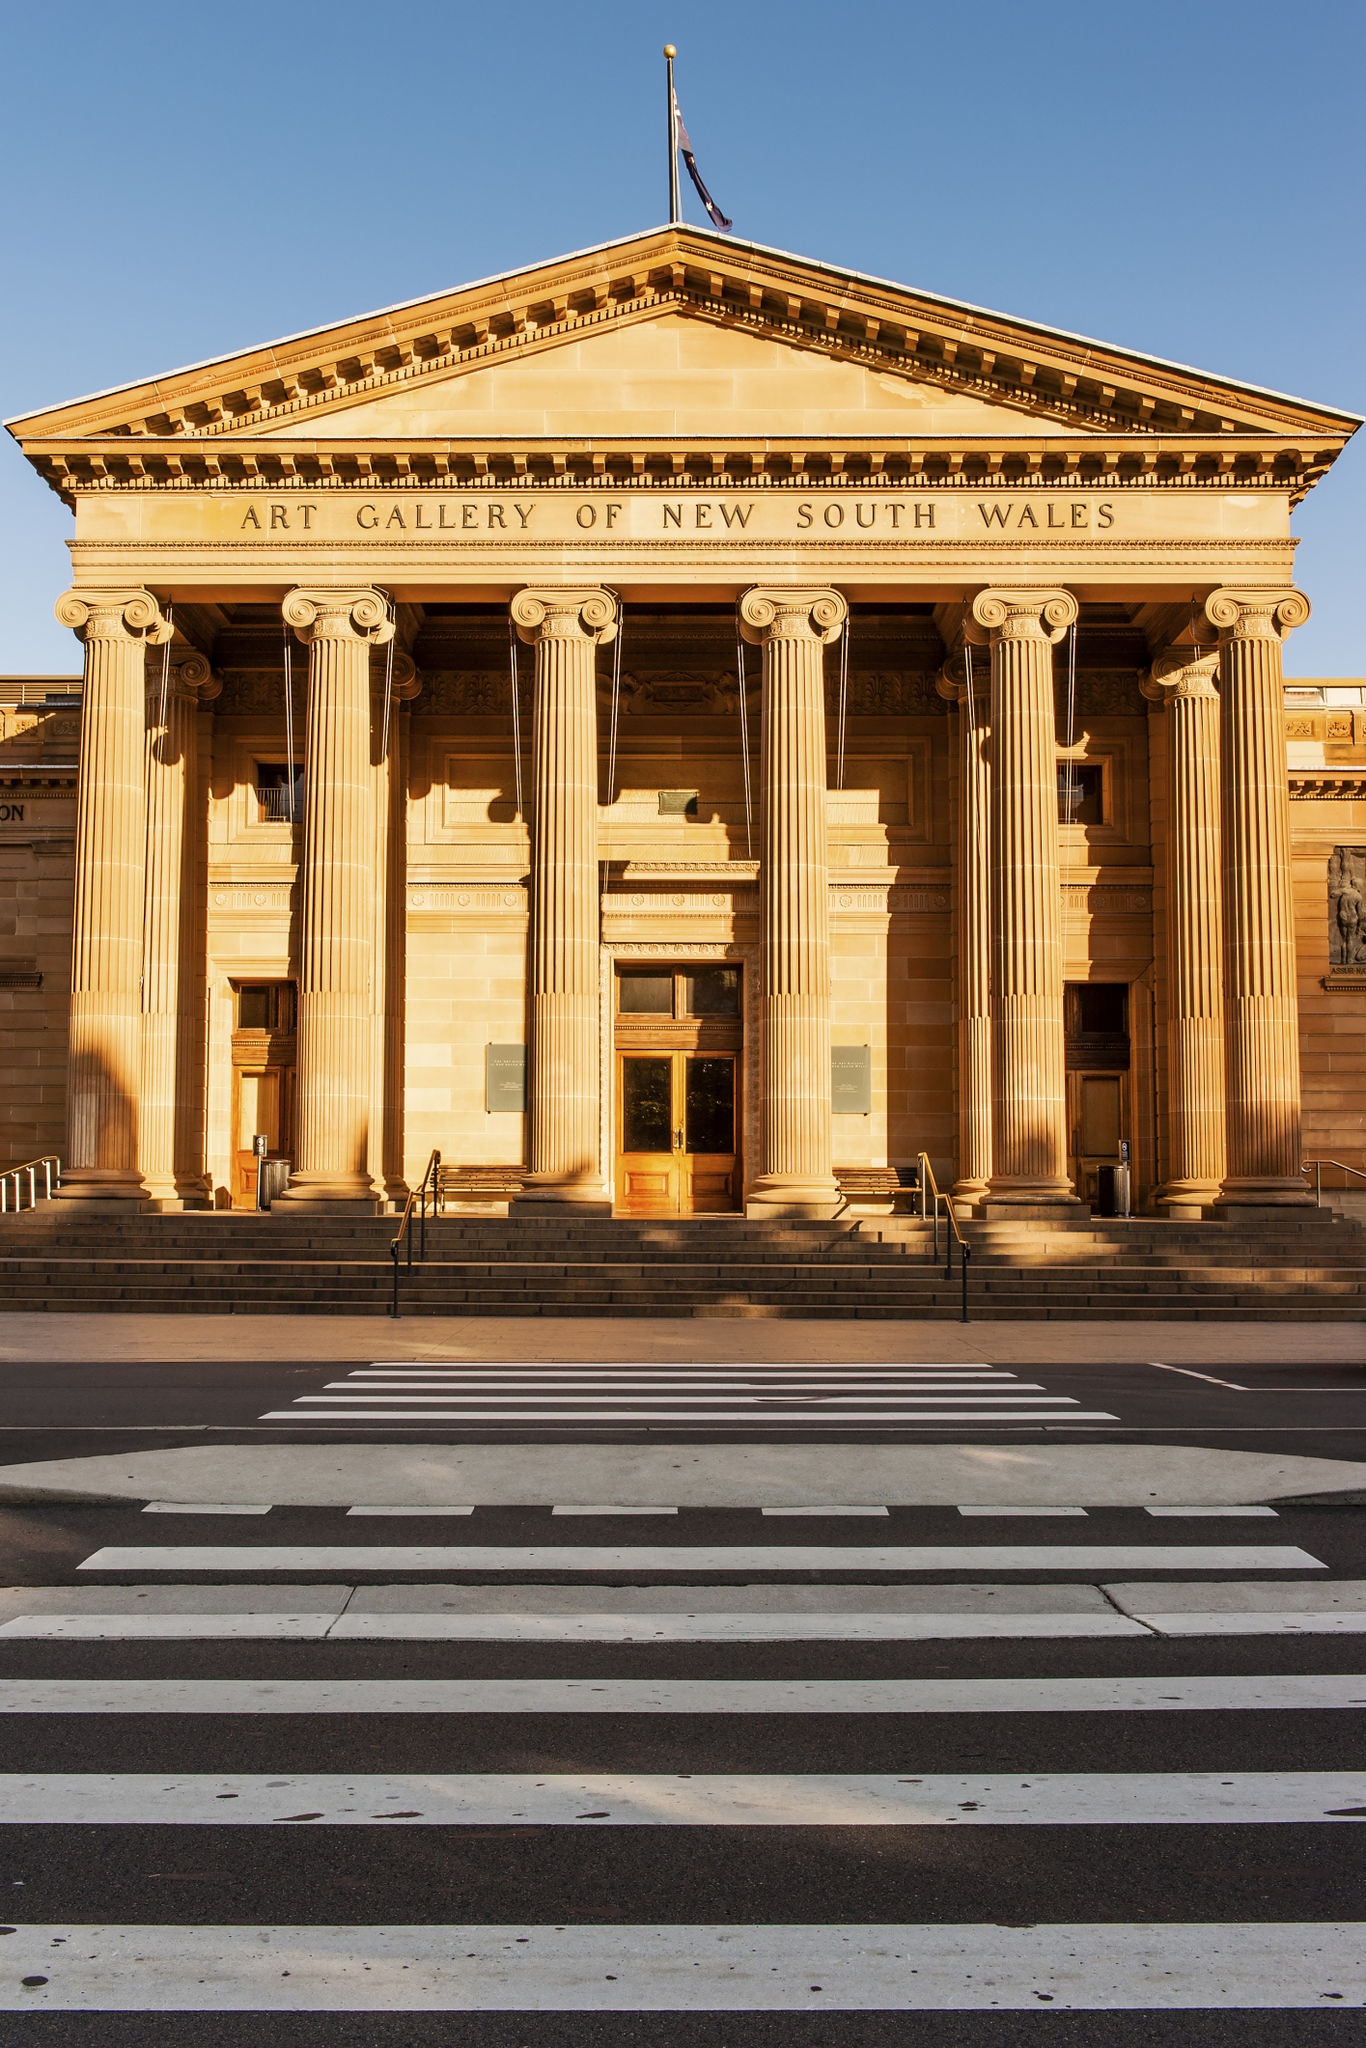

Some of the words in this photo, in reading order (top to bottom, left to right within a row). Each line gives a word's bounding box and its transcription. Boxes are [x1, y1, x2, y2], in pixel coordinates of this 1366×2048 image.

[241, 504, 317, 530] ART
[356, 504, 535, 529] GALLERY
[576, 503, 622, 529] OF
[662, 503, 755, 529] NEW
[796, 503, 936, 529] SOUTH
[977, 503, 1115, 529] WALES
